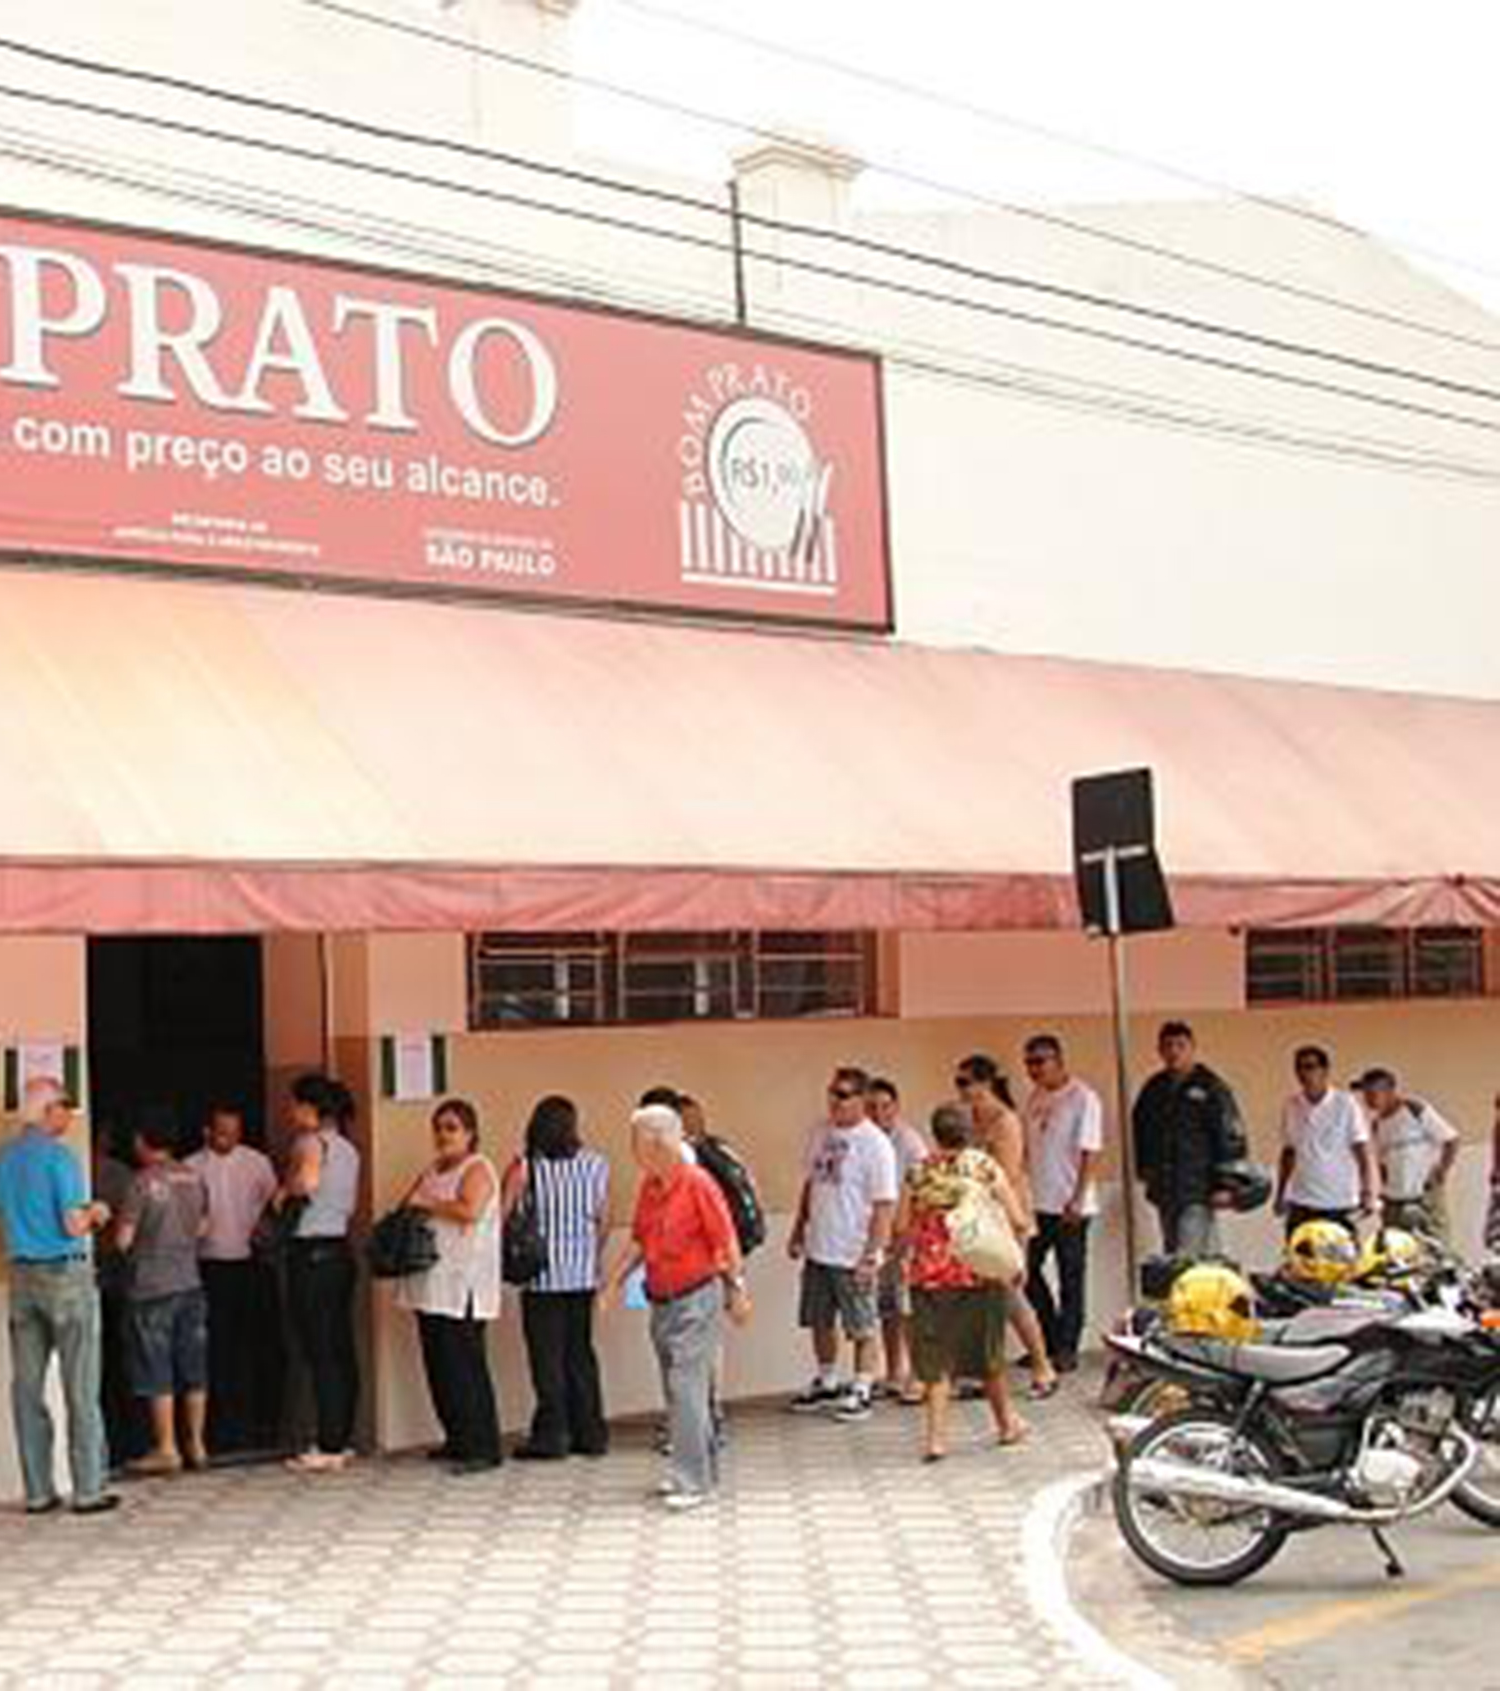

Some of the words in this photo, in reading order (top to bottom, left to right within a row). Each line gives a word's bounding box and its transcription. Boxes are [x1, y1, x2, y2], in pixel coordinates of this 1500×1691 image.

[13, 416, 111, 457] com
[126, 426, 249, 480] preço
[260, 439, 311, 480] ao
[323, 453, 394, 489] seu
[406, 455, 561, 507] alcance.
[681, 393, 714, 500] BOM
[706, 362, 812, 421] PRATO
[480, 549, 557, 577] PAULO
